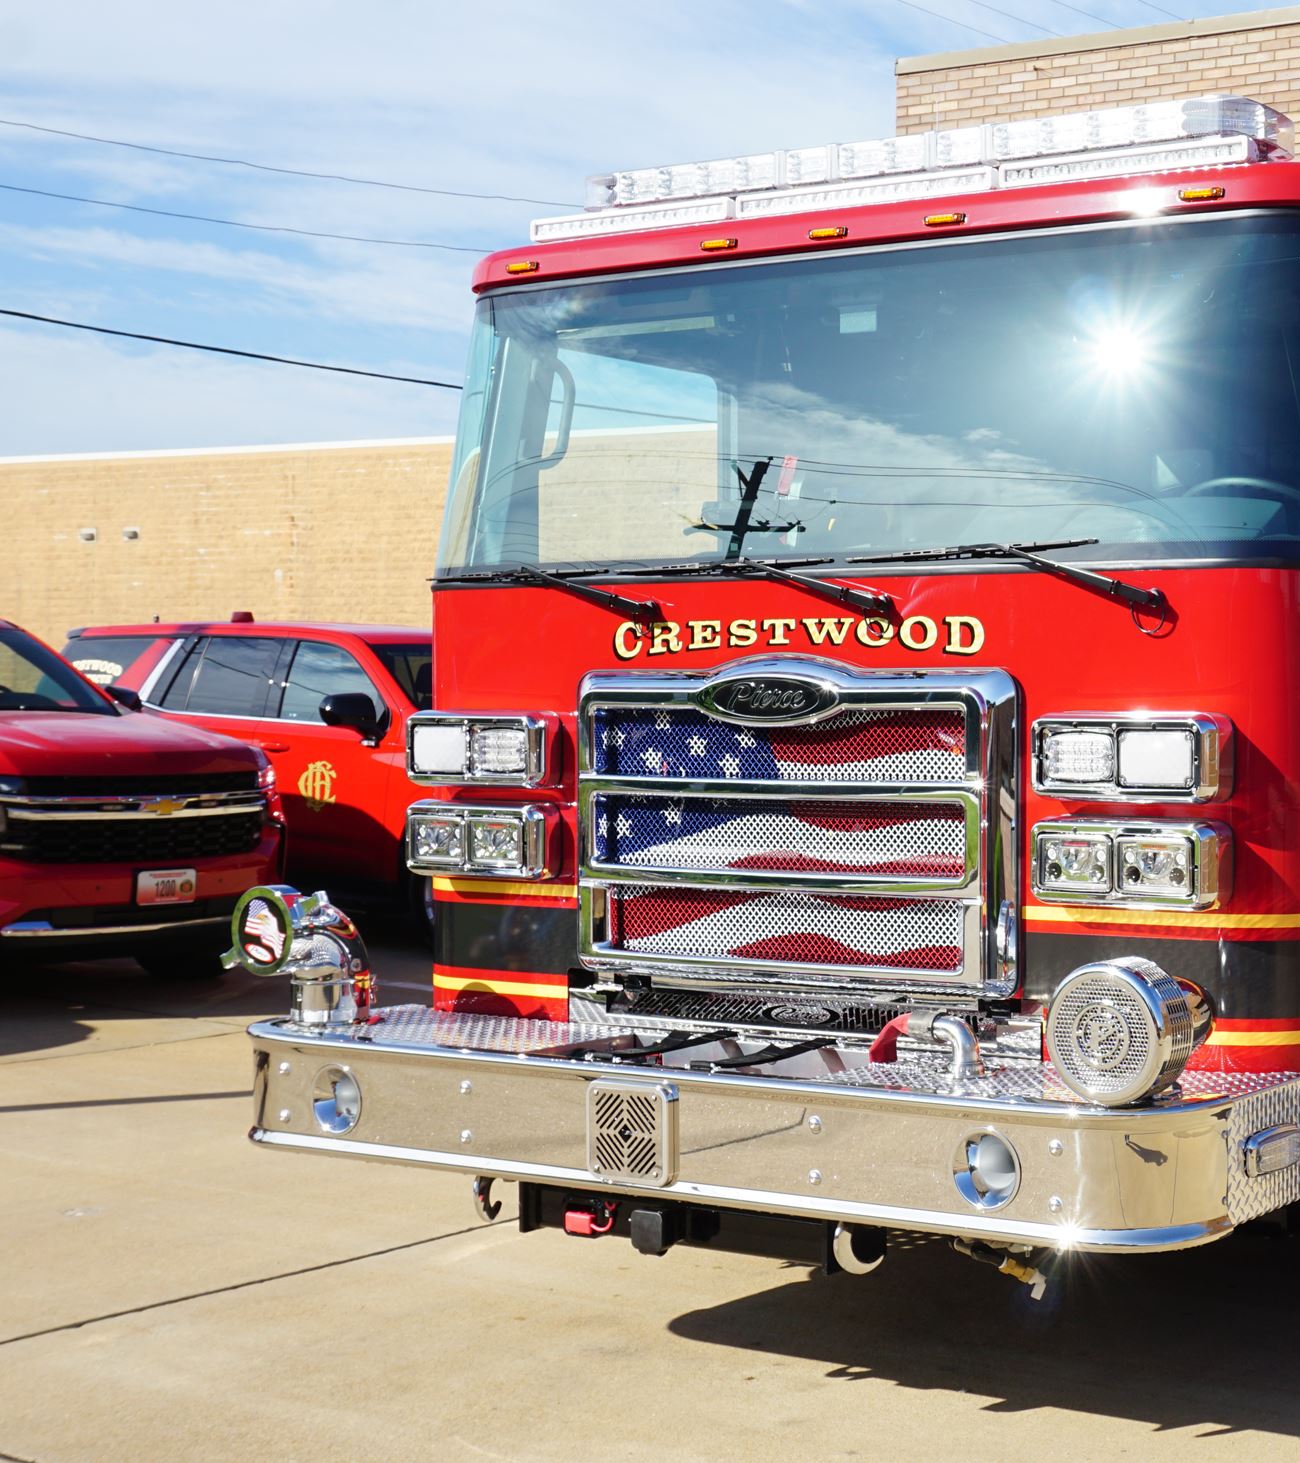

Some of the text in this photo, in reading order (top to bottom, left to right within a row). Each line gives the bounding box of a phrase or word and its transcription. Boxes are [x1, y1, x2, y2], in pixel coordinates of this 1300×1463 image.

[614, 616, 985, 659] CRESTWOOD
[727, 681, 806, 712] Pierce
[155, 880, 176, 897] 1200
